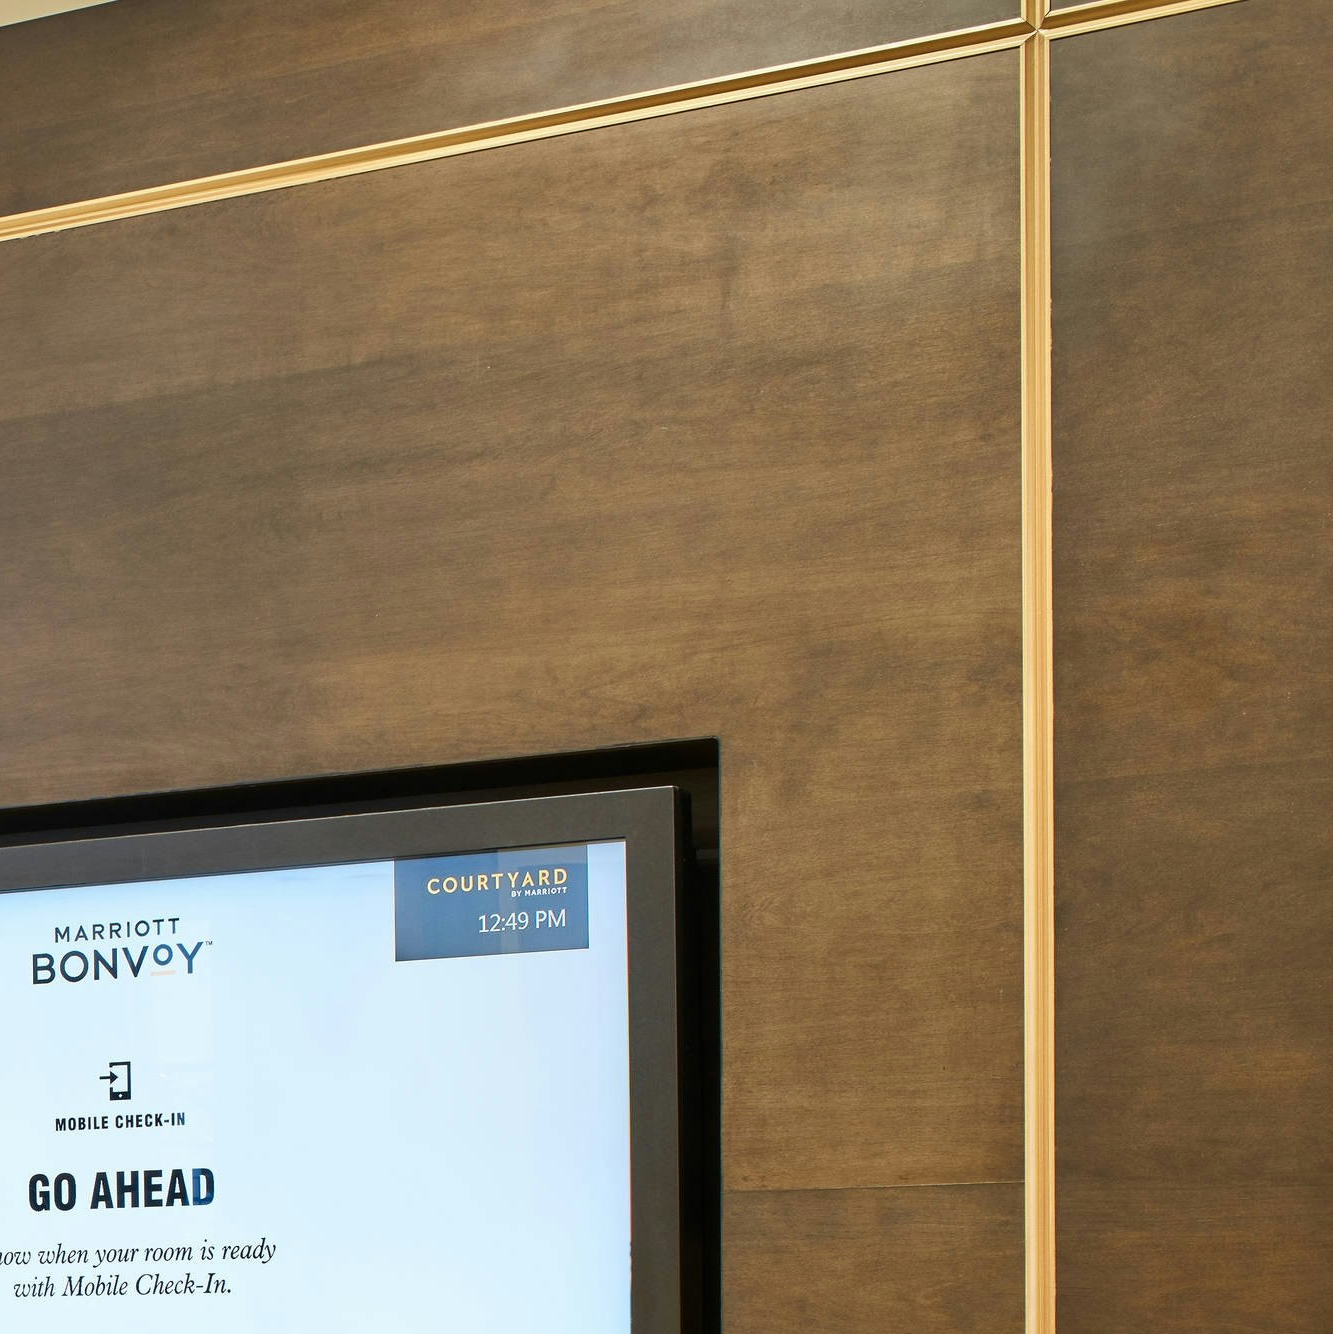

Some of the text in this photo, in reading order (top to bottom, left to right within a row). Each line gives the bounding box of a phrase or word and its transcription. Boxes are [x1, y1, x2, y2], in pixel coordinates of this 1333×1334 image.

[426, 867, 569, 895] COURTYARD
[511, 886, 568, 898] BY MARRIOTT
[54, 917, 180, 944] MARRIOTT
[478, 908, 567, 933] 12:49 PM
[54, 1112, 186, 1132] MOBILE CHECK-IN
[28, 1167, 215, 1212] GO AHEAD
[37, 1243, 89, 1265] when
[92, 1247, 138, 1268] your
[144, 1246, 193, 1262] room
[200, 1239, 215, 1261] is
[221, 1237, 277, 1264] ready
[13, 1272, 232, 1298] with Mobile Check-In.
